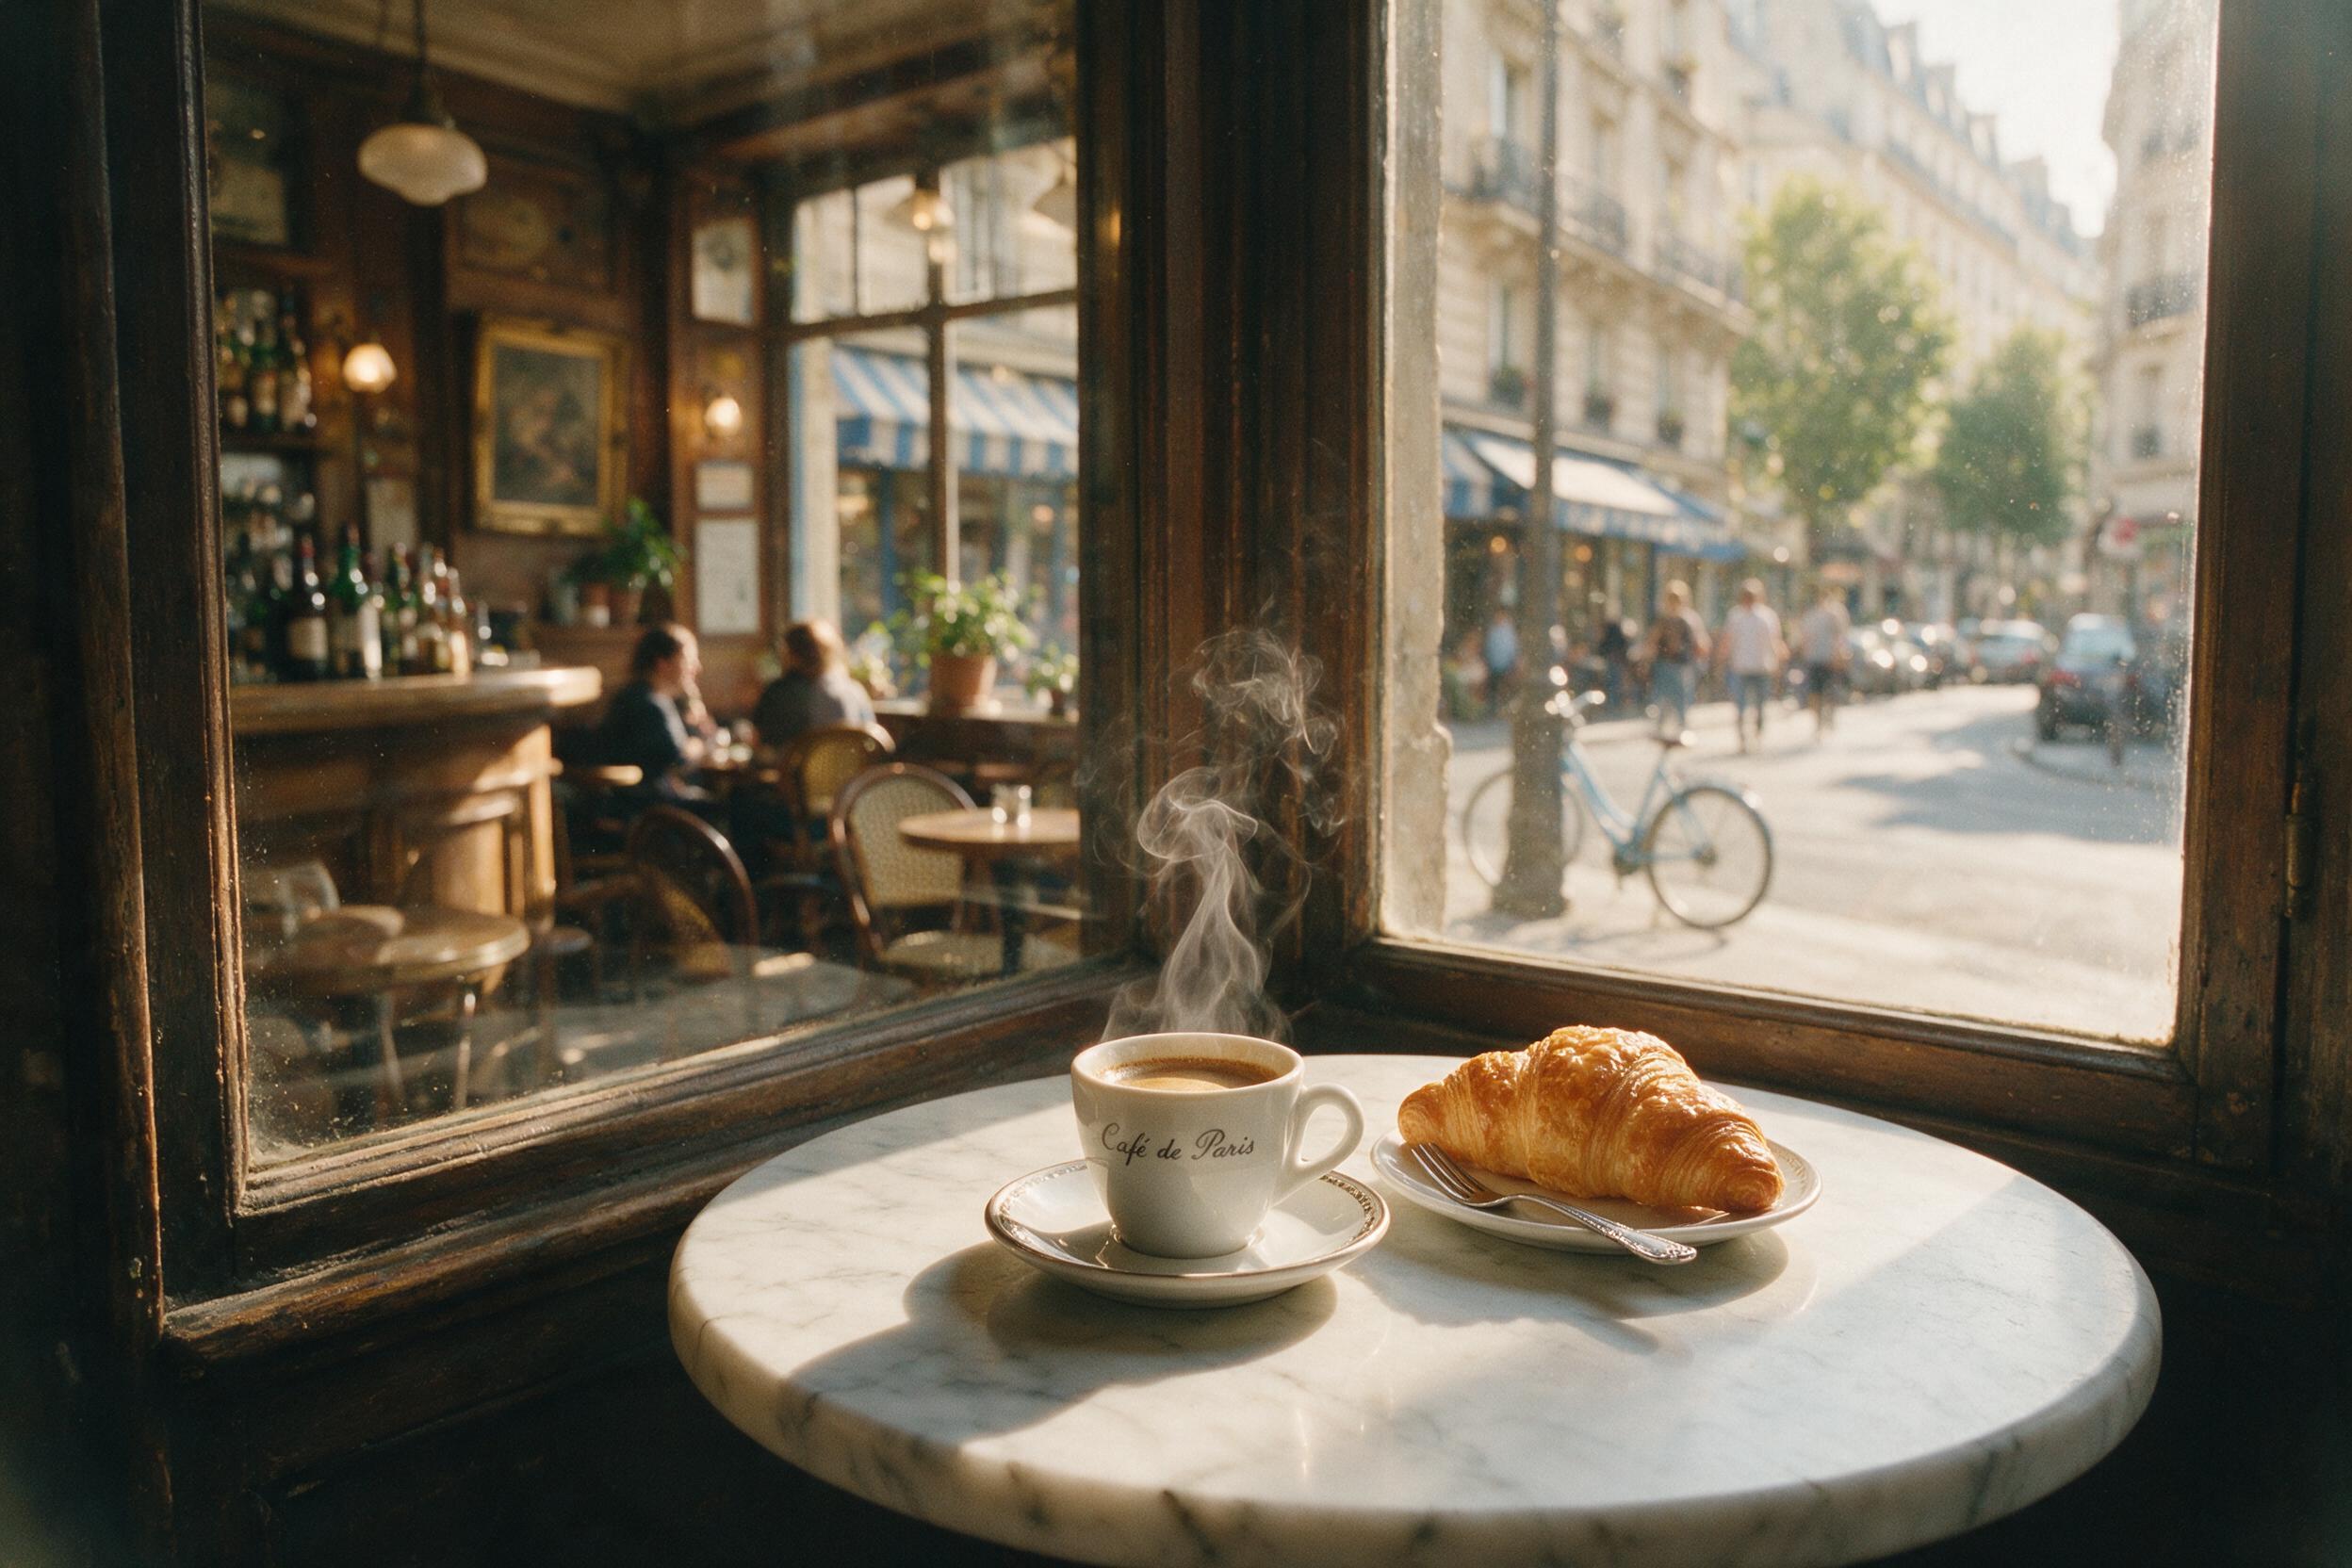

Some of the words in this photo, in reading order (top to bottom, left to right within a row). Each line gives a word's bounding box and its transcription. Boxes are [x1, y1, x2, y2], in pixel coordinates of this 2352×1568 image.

[1102, 1122, 1150, 1166] Café
[1157, 1138, 1182, 1160] de
[1191, 1129, 1255, 1160] Paris
